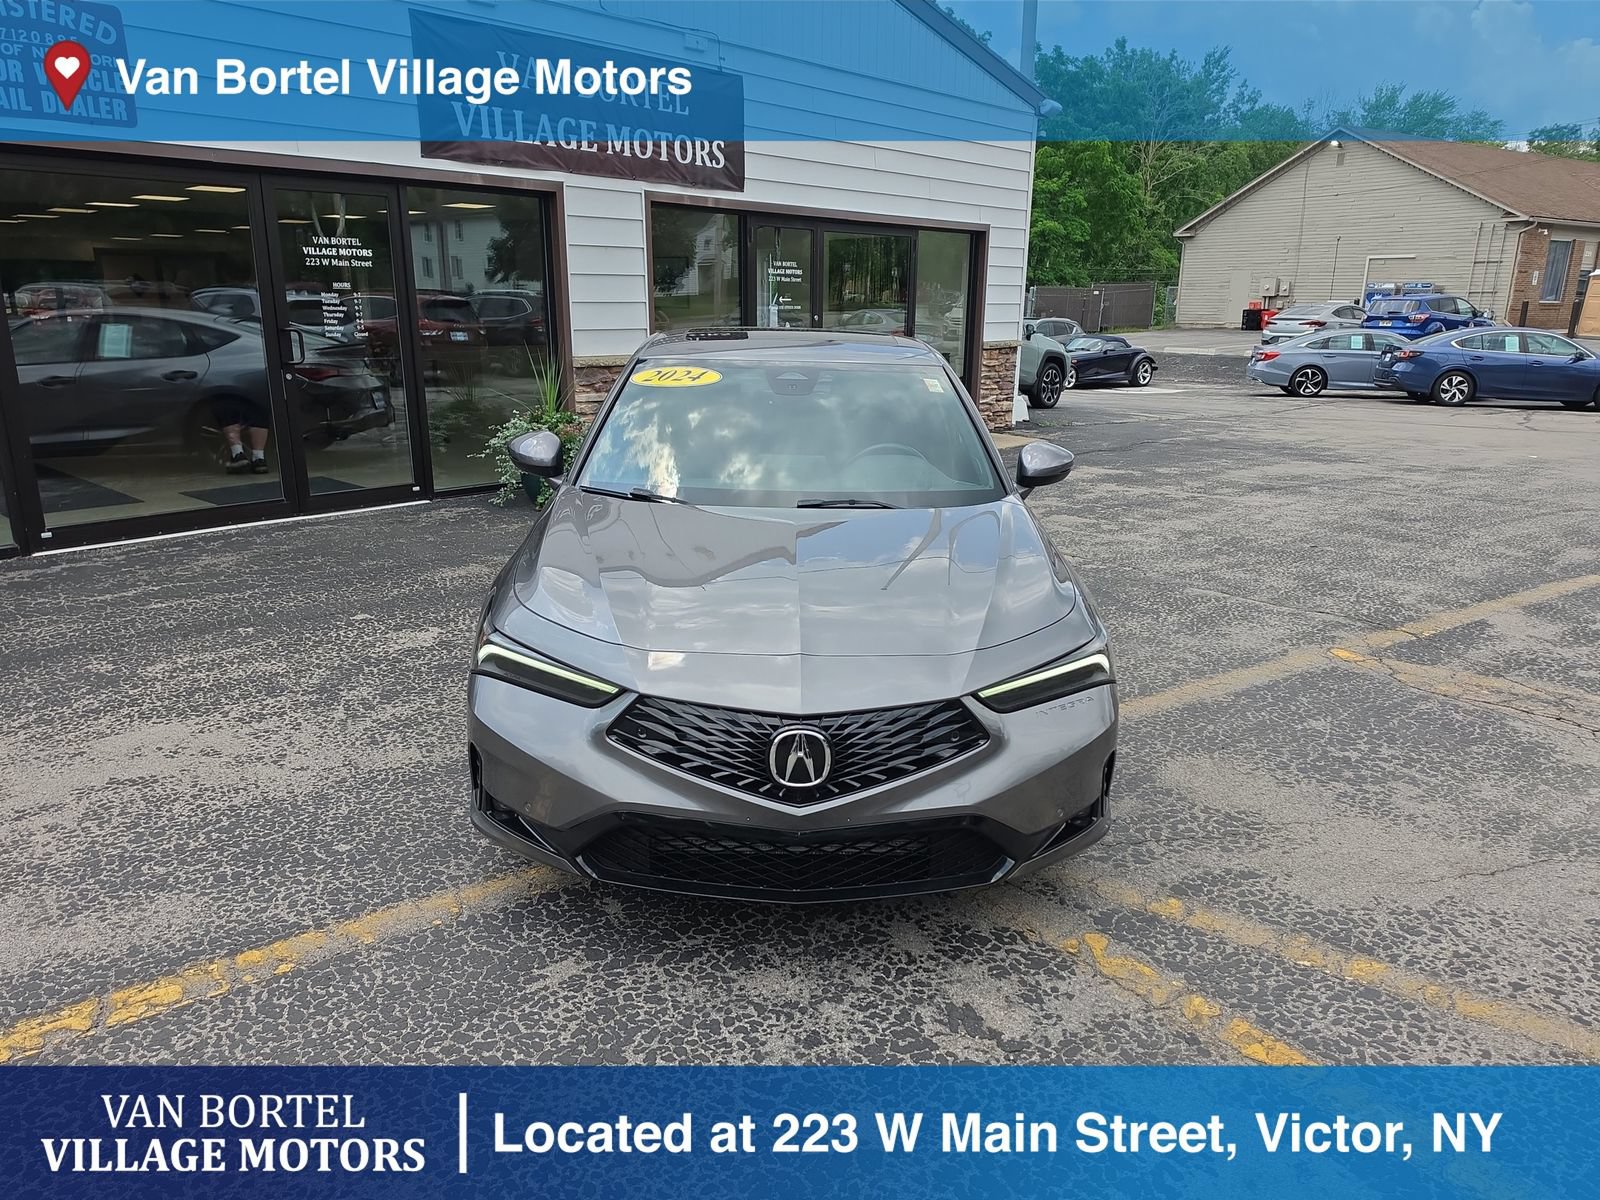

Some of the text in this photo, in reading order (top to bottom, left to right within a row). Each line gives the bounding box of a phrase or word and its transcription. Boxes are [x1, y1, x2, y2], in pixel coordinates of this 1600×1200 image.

[1, 43, 24, 56] OF
[451, 102, 725, 170] VILLAGE MOTORS
[312, 236, 361, 246] VAN BORTEL
[302, 246, 373, 257] VILLAGE MOTORS
[305, 257, 373, 268] 223 W Main Street
[641, 369, 710, 382] 2024
